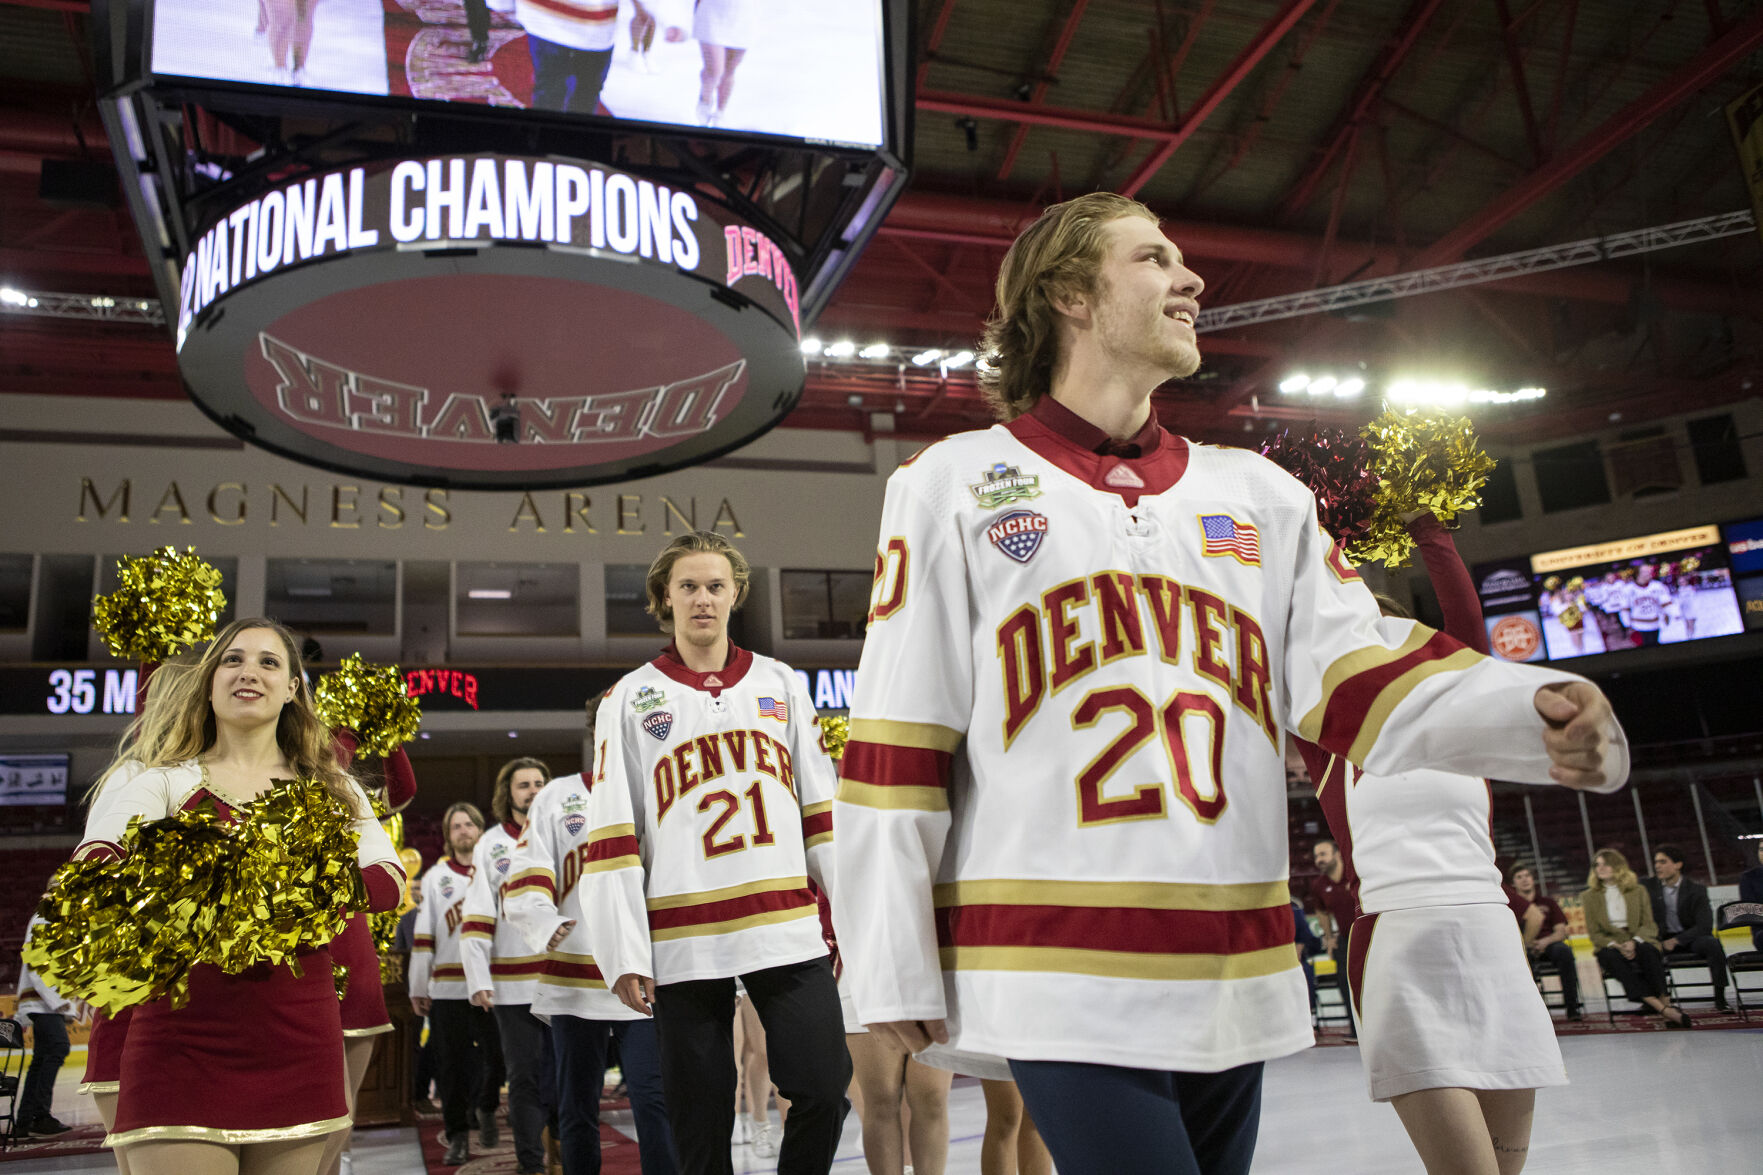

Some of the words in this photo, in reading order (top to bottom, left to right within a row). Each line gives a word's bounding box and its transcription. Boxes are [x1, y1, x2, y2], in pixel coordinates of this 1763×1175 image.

[194, 168, 378, 314] NATIONAL
[390, 159, 700, 271] CHAMPIONS
[259, 331, 747, 445] DENVER
[75, 477, 453, 531] MAGNESS
[508, 491, 746, 538] ARENA
[990, 516, 1046, 541] NCHC
[47, 669, 96, 714] 35
[402, 669, 479, 711] ENVER
[815, 669, 858, 708] AN
[996, 570, 1280, 757] DENVER
[644, 714, 672, 729] NCHC
[1070, 683, 1228, 829] 20
[654, 729, 800, 829] DENVER
[696, 780, 775, 861] 21
